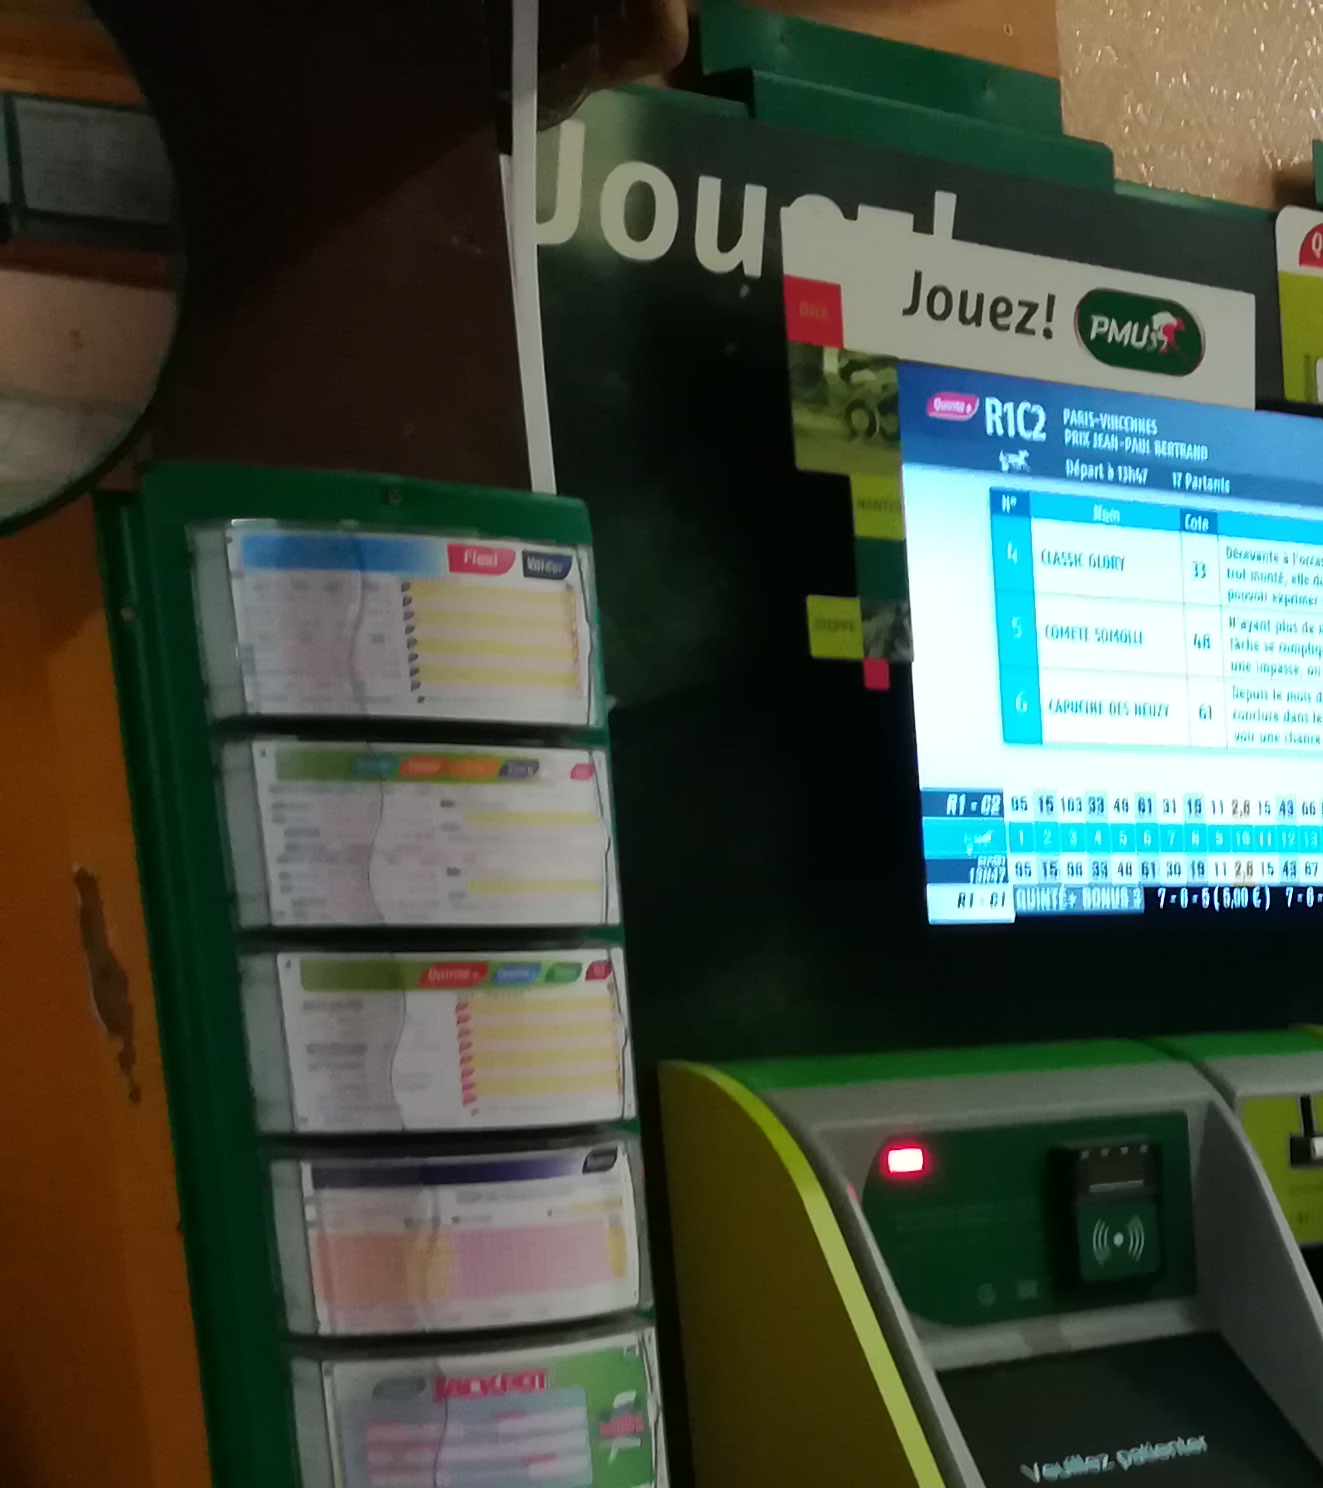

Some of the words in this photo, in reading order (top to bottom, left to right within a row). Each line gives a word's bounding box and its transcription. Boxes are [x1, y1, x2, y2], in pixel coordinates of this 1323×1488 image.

[903, 270, 1056, 339] Jouez!
[1091, 312, 1151, 350] PMU
[985, 397, 1047, 442] R1C2
[1063, 408, 1158, 435] PARIS-VINCENNES
[1066, 458, 1104, 482] Départ
[1185, 472, 1230, 493] Partants
[1185, 515, 1209, 532] Cote
[1041, 549, 1084, 568] CLASSIC
[1019, 829, 1024, 846] 1
[1043, 829, 1052, 845] 2
[1094, 830, 1102, 846] 4
[1119, 830, 1127, 846] 5
[1143, 830, 1152, 846] 6
[1168, 830, 1175, 846] 7
[1191, 830, 1200, 847] 8
[1215, 830, 1223, 846] 9
[1236, 830, 1250, 847] 10
[1259, 831, 1272, 846] 11
[1281, 831, 1296, 846] 12
[1304, 831, 1318, 846] 13
[1019, 1452, 1110, 1483] Veuillez
[1116, 1435, 1208, 1471] patienter
